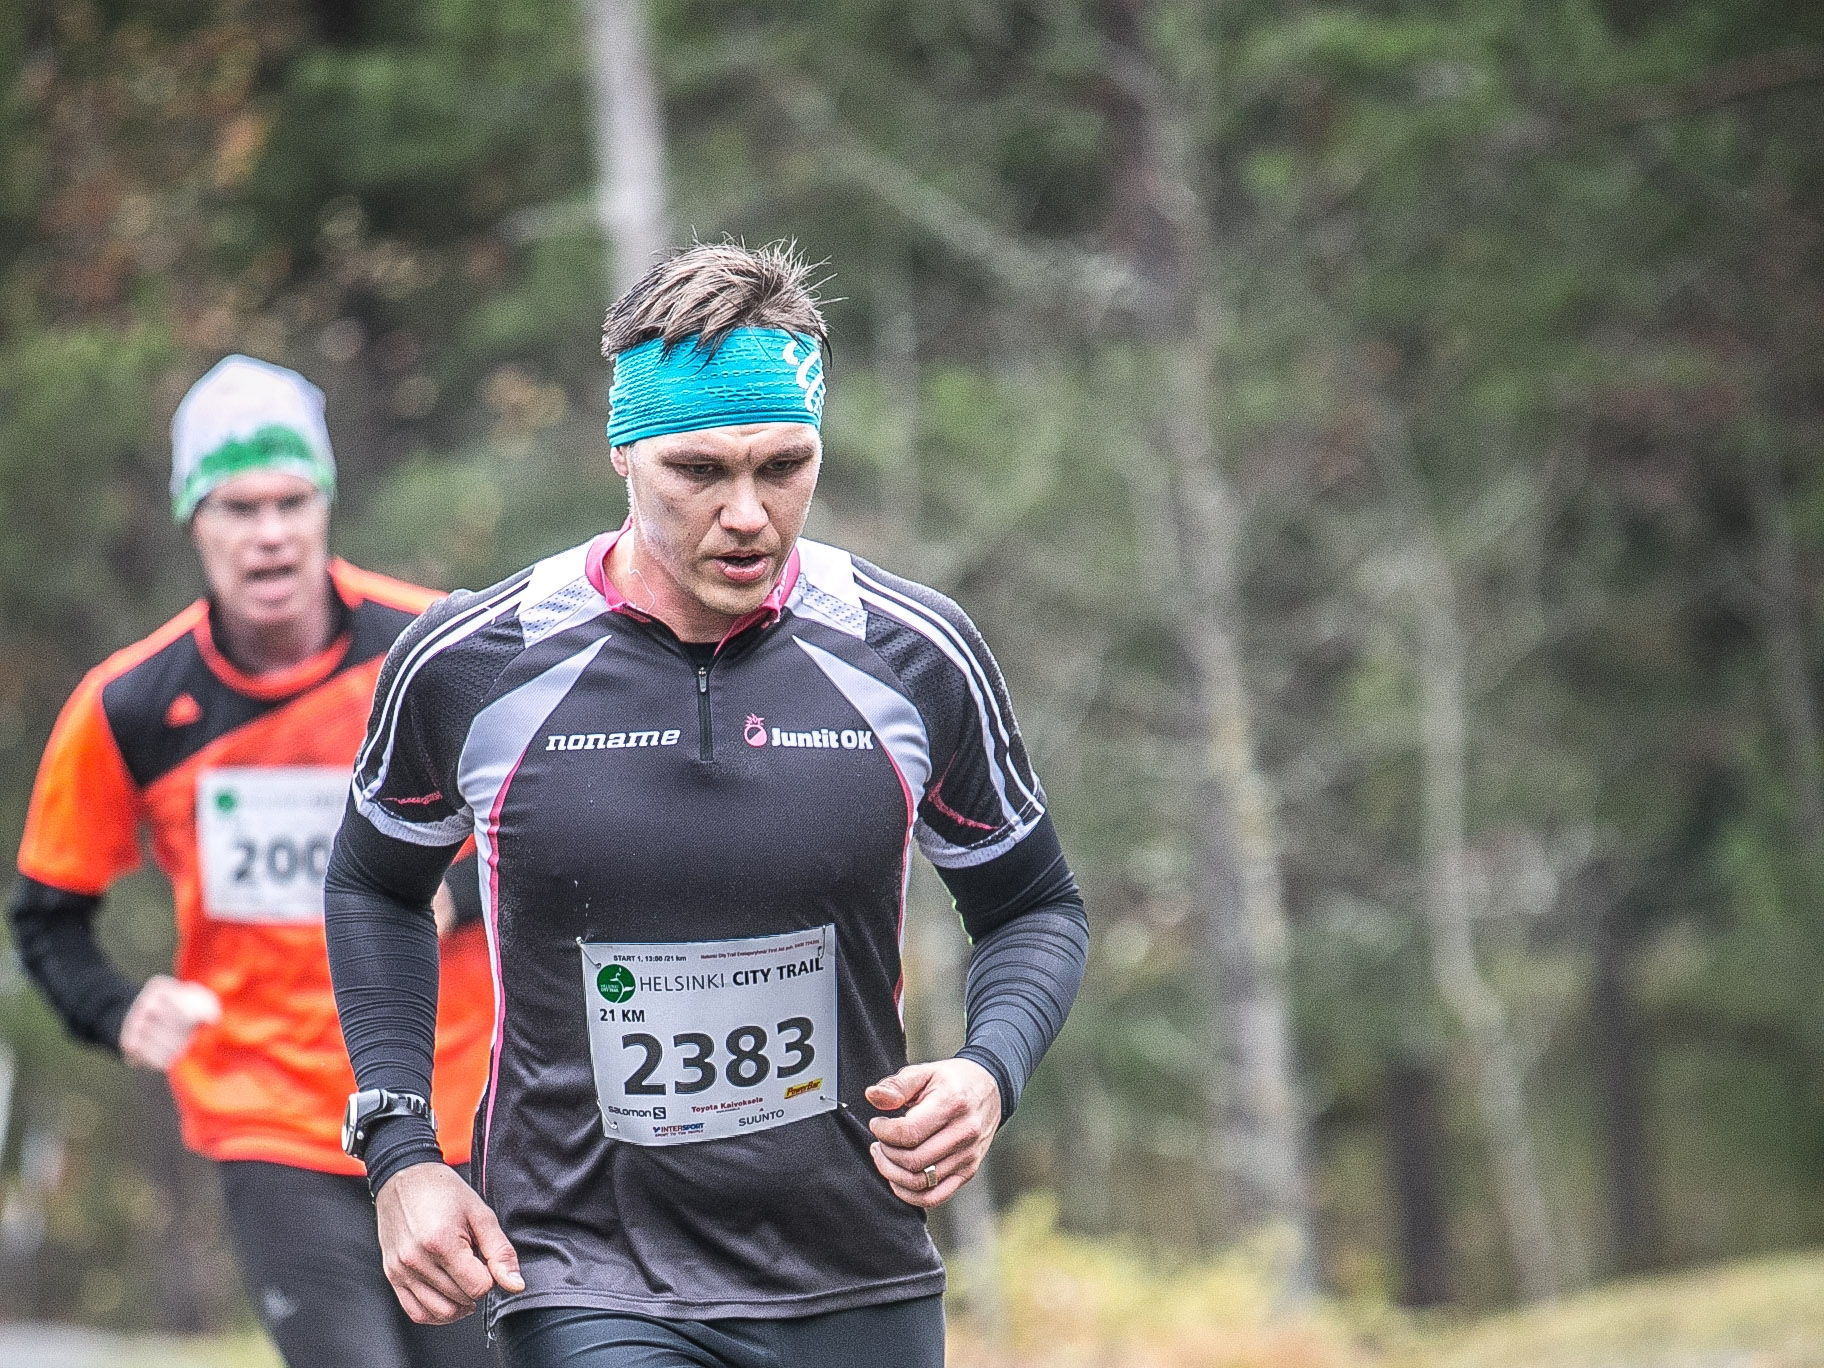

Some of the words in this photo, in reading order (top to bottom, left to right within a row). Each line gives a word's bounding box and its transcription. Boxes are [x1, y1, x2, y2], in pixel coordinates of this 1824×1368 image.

[545, 729, 681, 751] noname
[771, 727, 840, 749] Juntit
[841, 729, 875, 750] OK
[640, 973, 725, 992] HELSINKI
[732, 967, 772, 987] CITY
[776, 957, 824, 981] TRAIL
[600, 1008, 616, 1022] 21
[622, 1009, 646, 1022] KM
[621, 1016, 816, 1096] 2383
[786, 1080, 820, 1098] PowerBar
[608, 1105, 652, 1118] salomon
[691, 1104, 719, 1114] Toyota
[738, 1109, 785, 1127] SUUNTO
[661, 1122, 705, 1132] INTERSPORT
